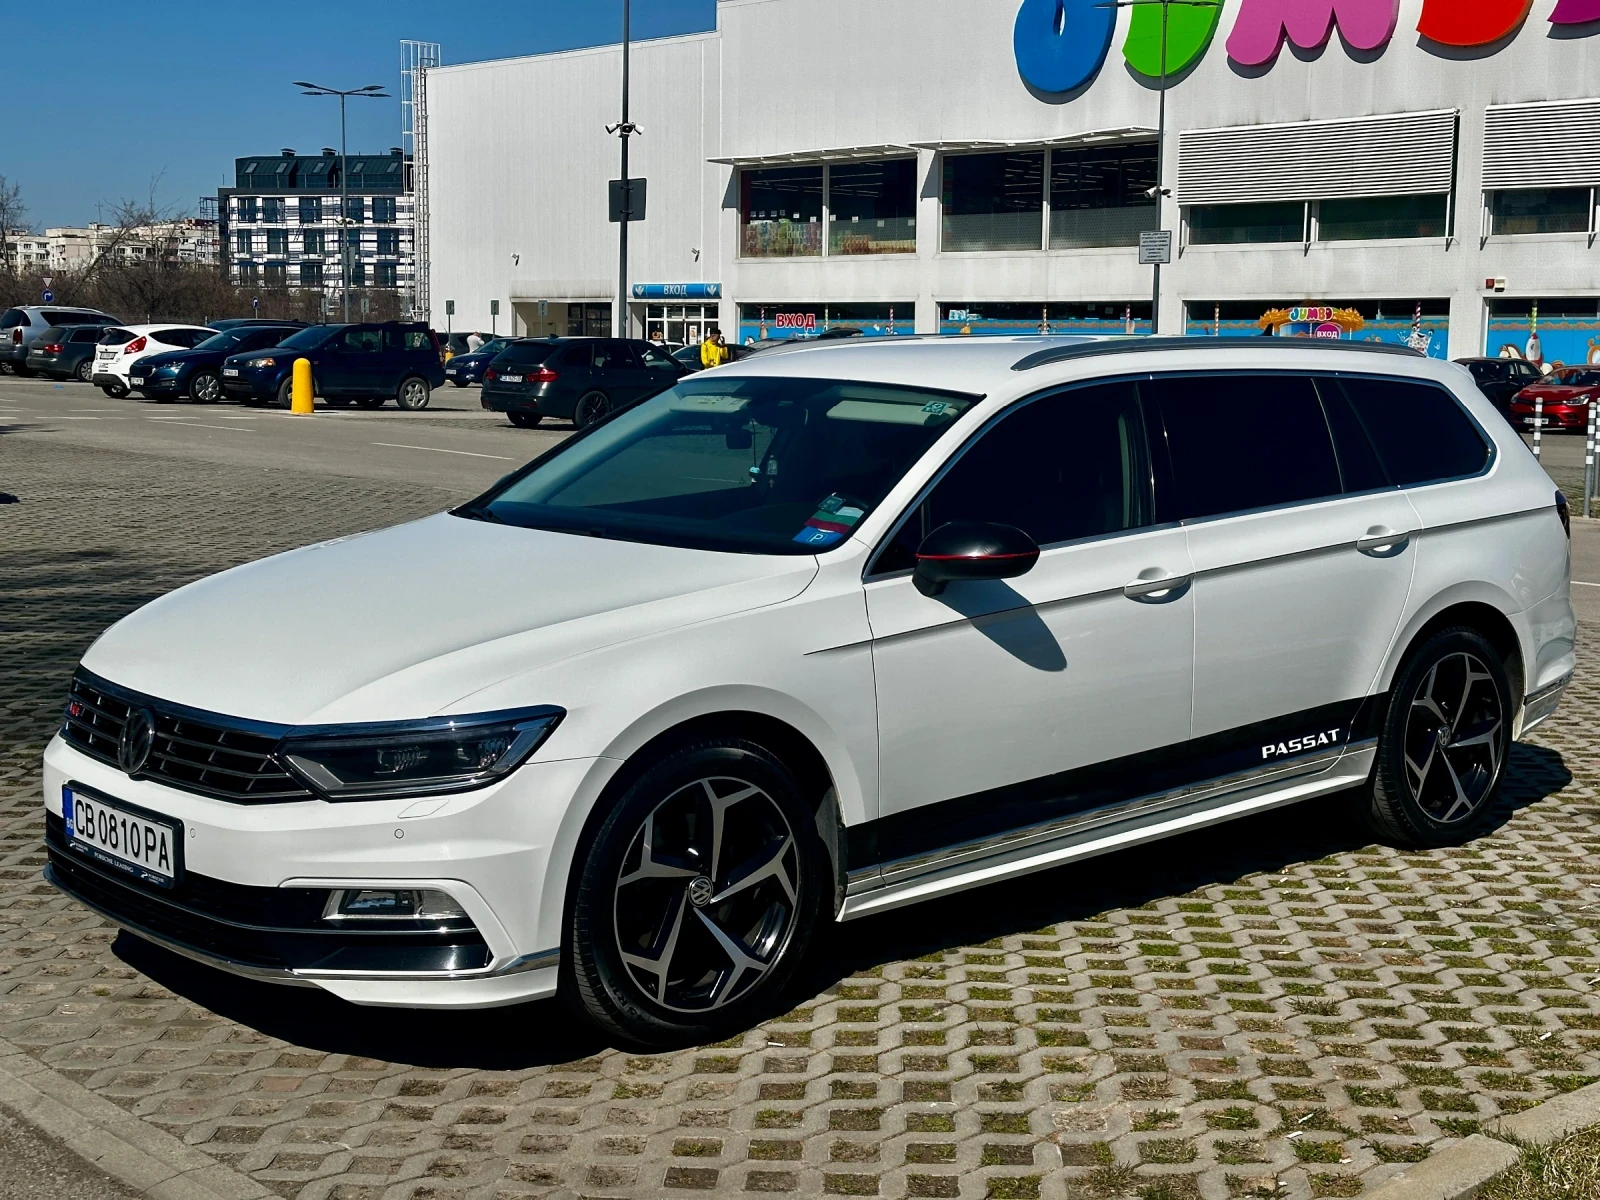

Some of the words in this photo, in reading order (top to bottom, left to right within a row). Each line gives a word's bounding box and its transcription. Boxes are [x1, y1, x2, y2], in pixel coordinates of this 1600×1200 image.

[663, 284, 687, 296] ВХОД
[1290, 306, 1333, 321] JUMBO
[775, 313, 815, 332] ВХОД
[1316, 330, 1338, 338] ВХОД
[1261, 728, 1340, 759] PASSAT
